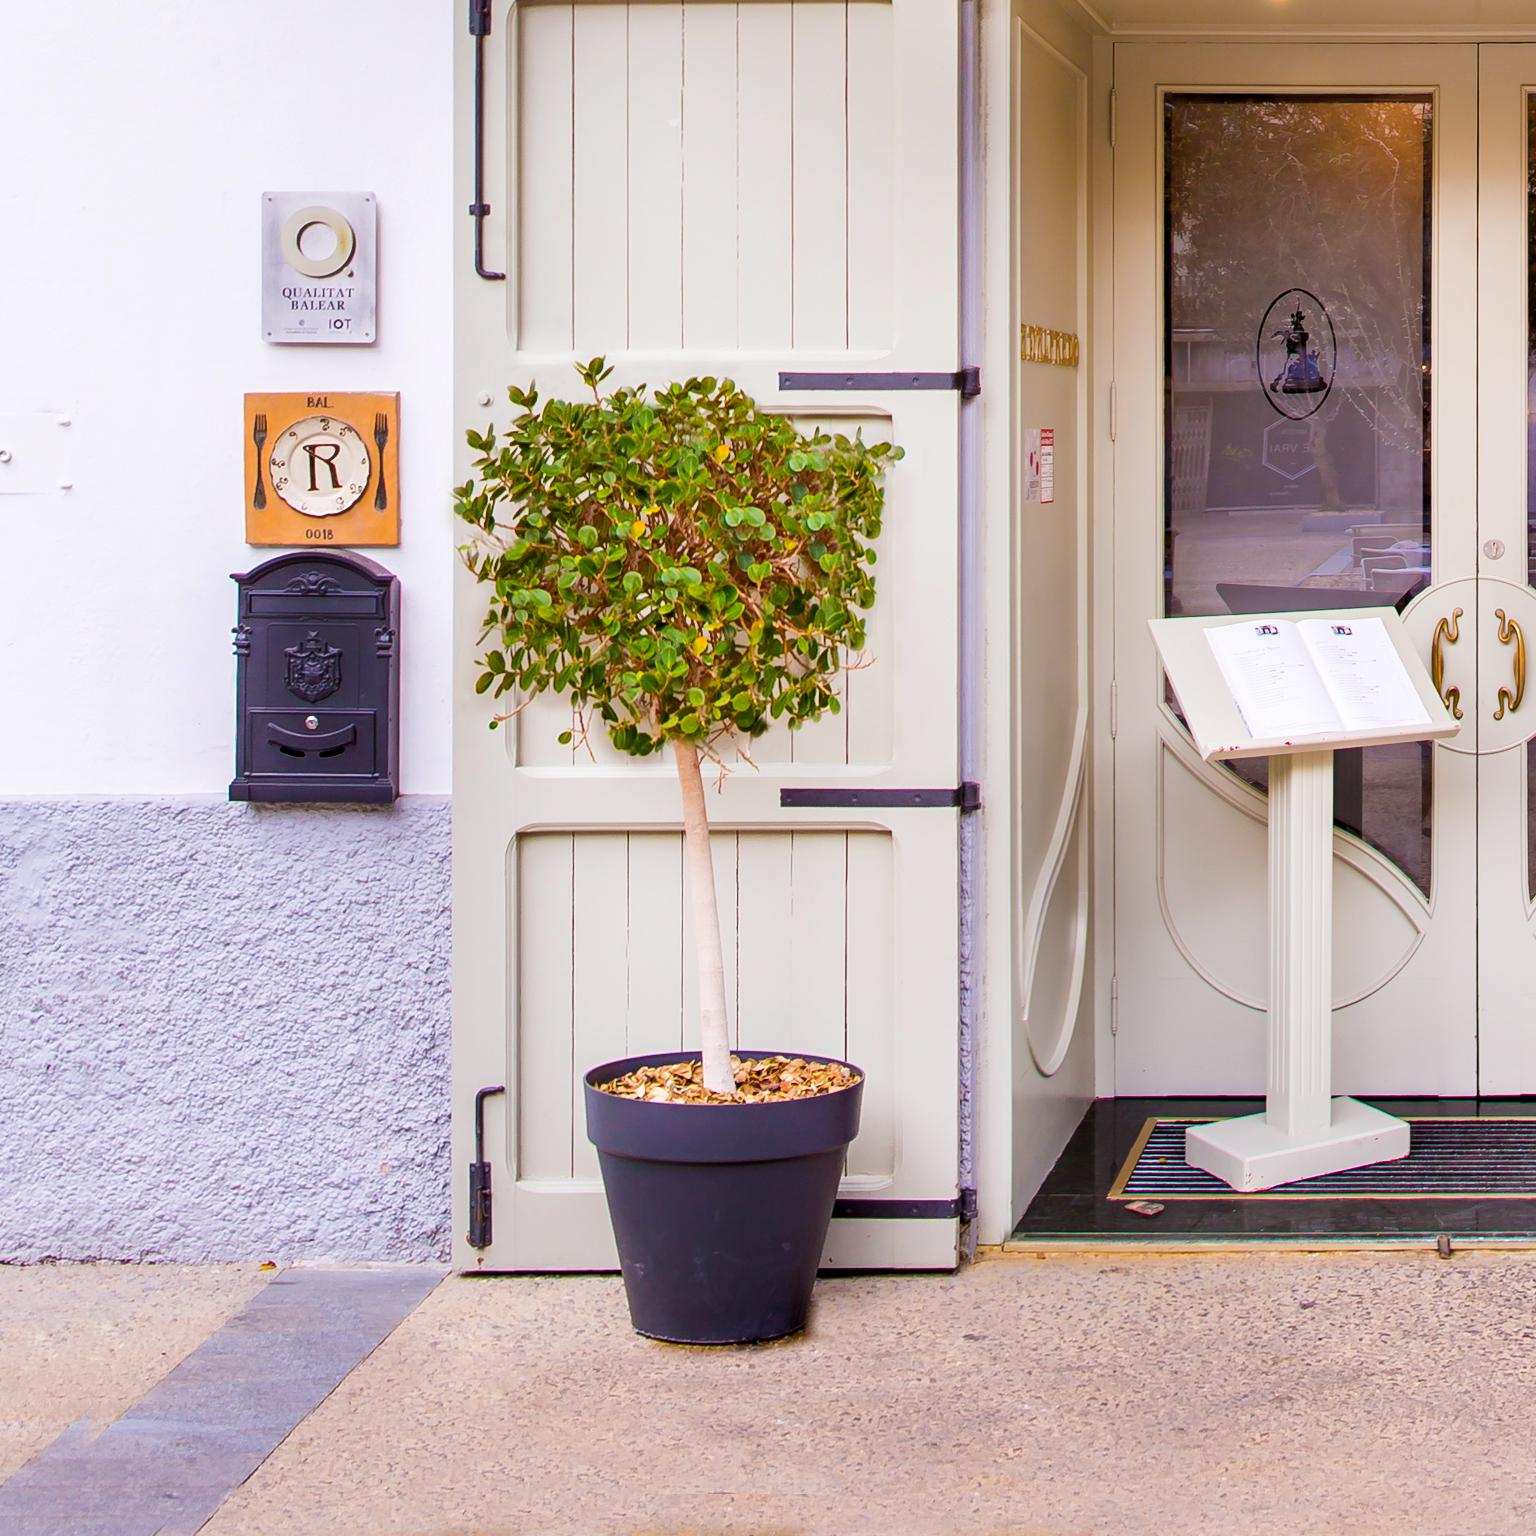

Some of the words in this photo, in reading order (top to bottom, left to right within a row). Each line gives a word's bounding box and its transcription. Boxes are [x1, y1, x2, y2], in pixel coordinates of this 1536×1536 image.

[282, 287, 355, 301] QUALITAT
[290, 300, 346, 311] BALEAR
[328, 318, 352, 330] IOT
[302, 443, 343, 492] R
[305, 528, 334, 541] 0018
